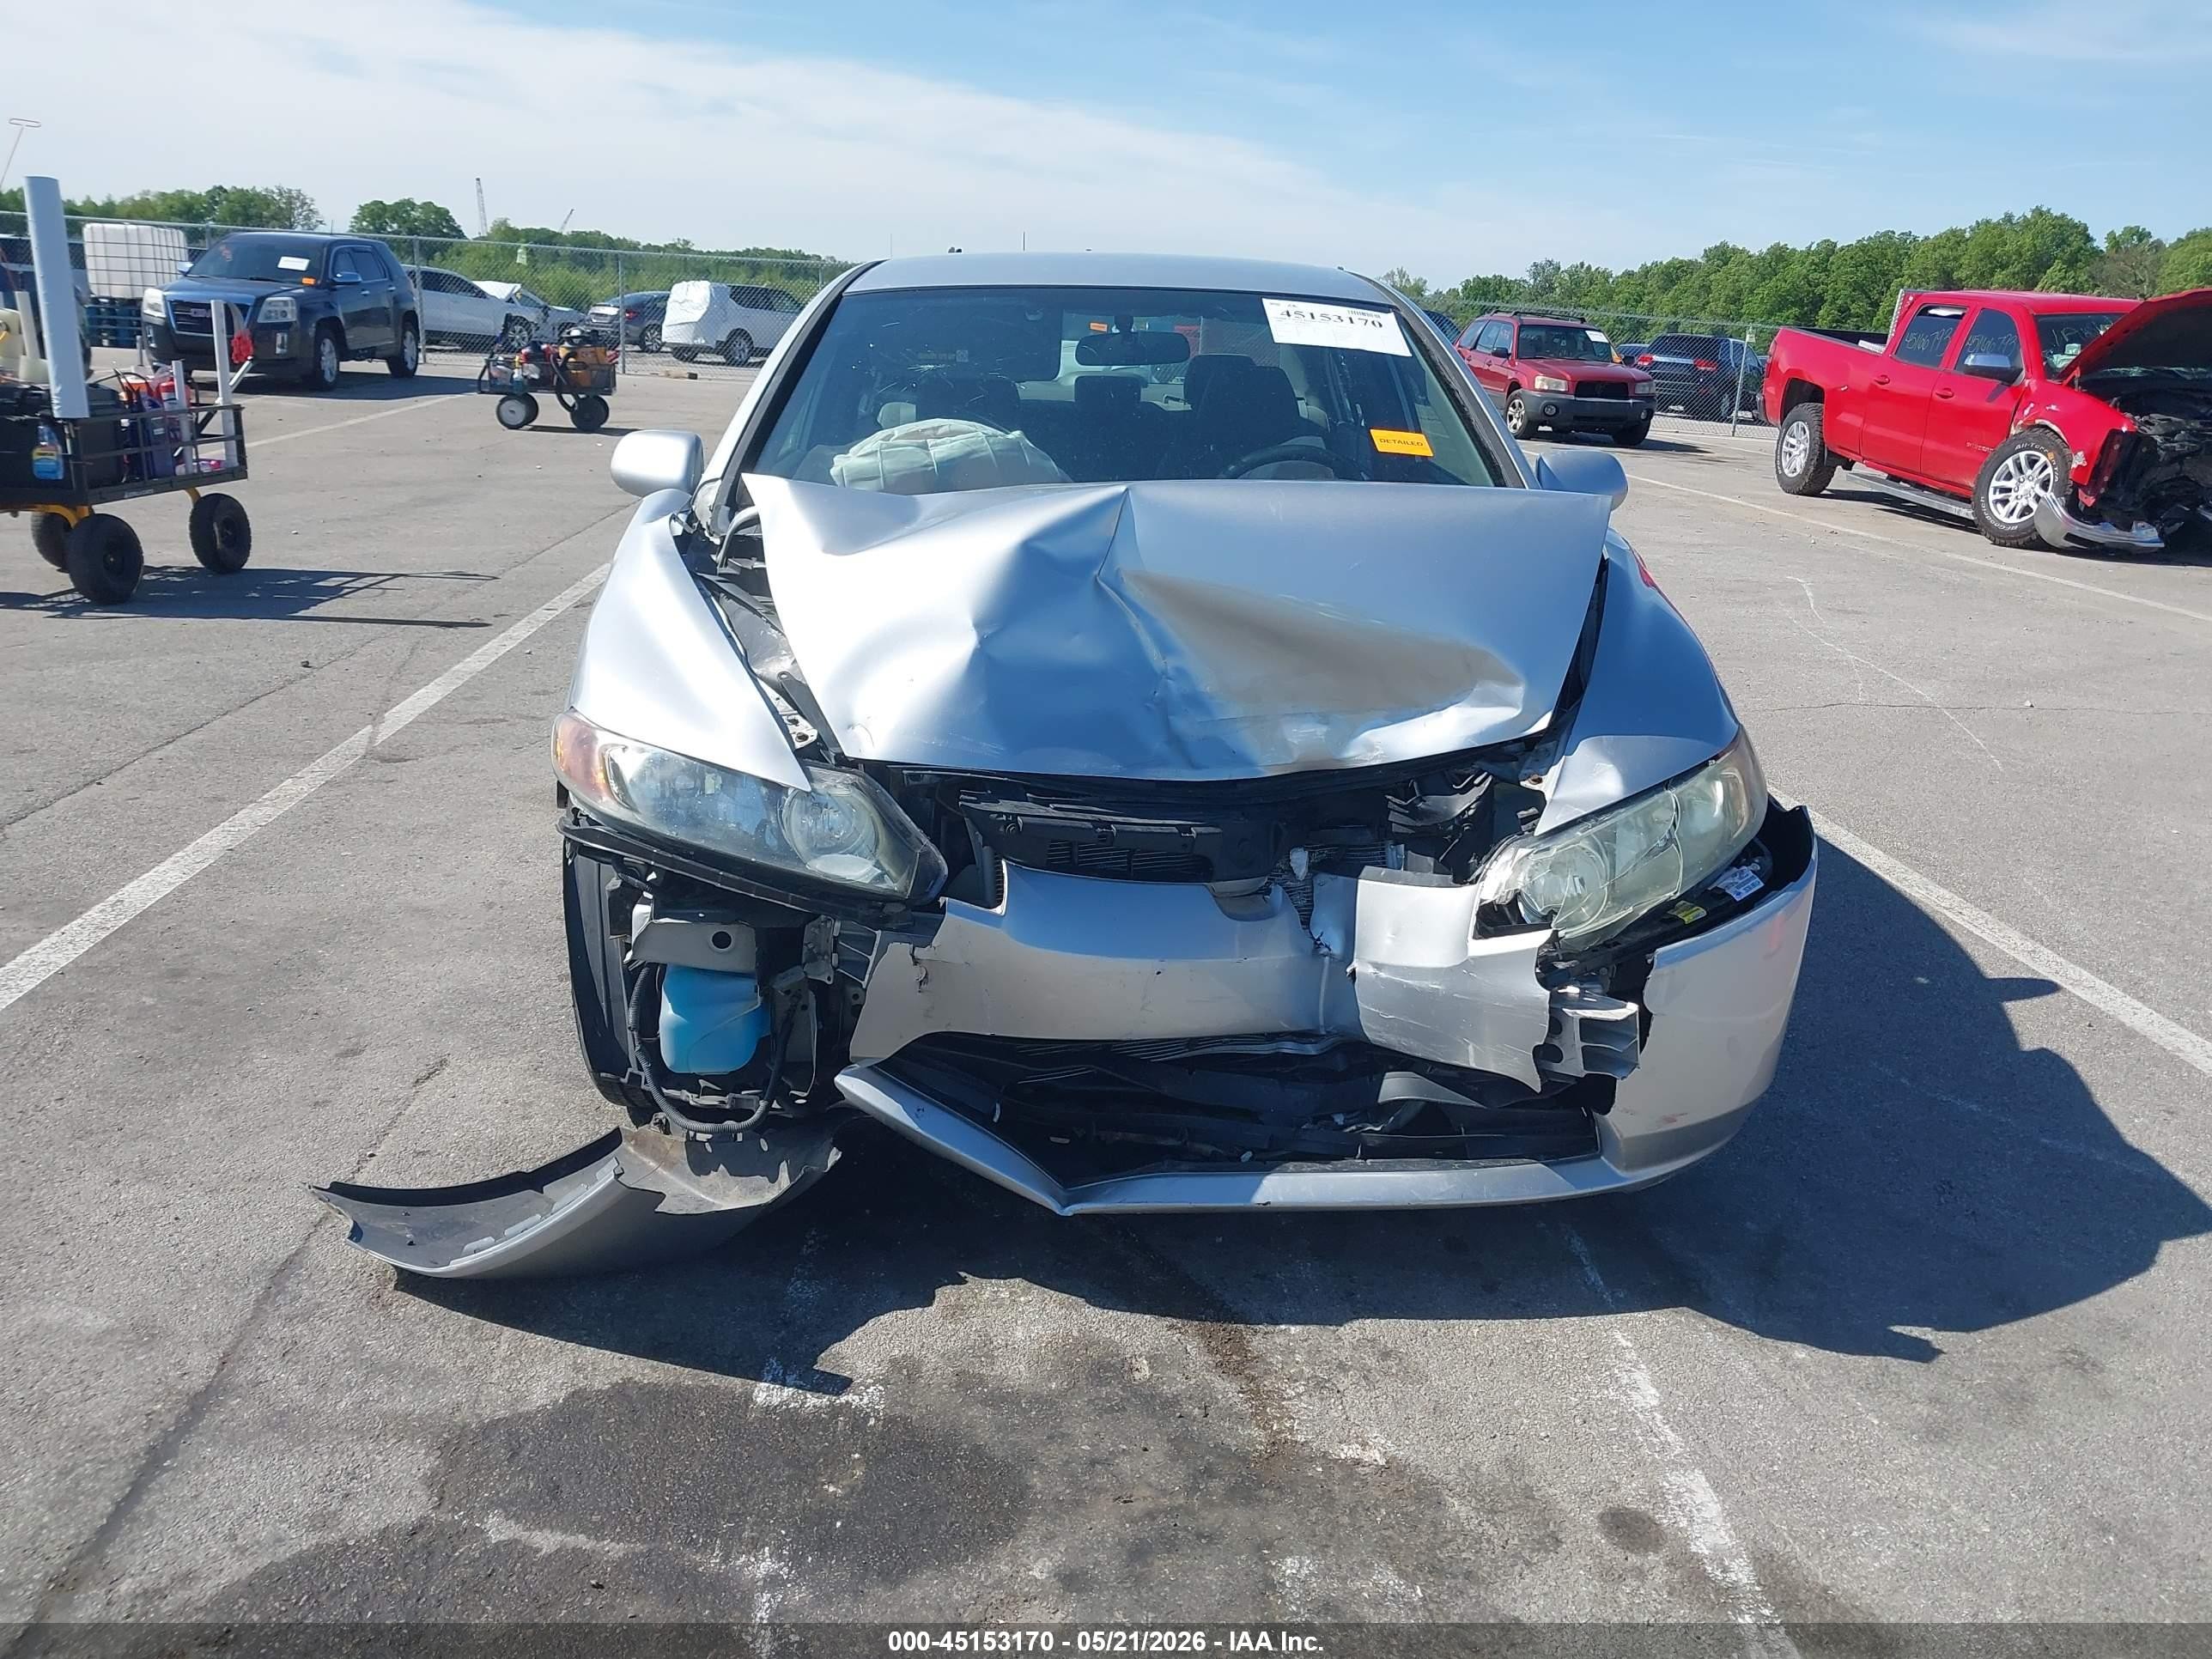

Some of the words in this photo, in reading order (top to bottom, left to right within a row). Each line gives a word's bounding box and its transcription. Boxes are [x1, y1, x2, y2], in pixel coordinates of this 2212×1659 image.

[1280, 310, 1382, 328] 45153170
[1379, 438, 1424, 447] DETAILED
[1980, 495, 2018, 531] BFGoodrich
